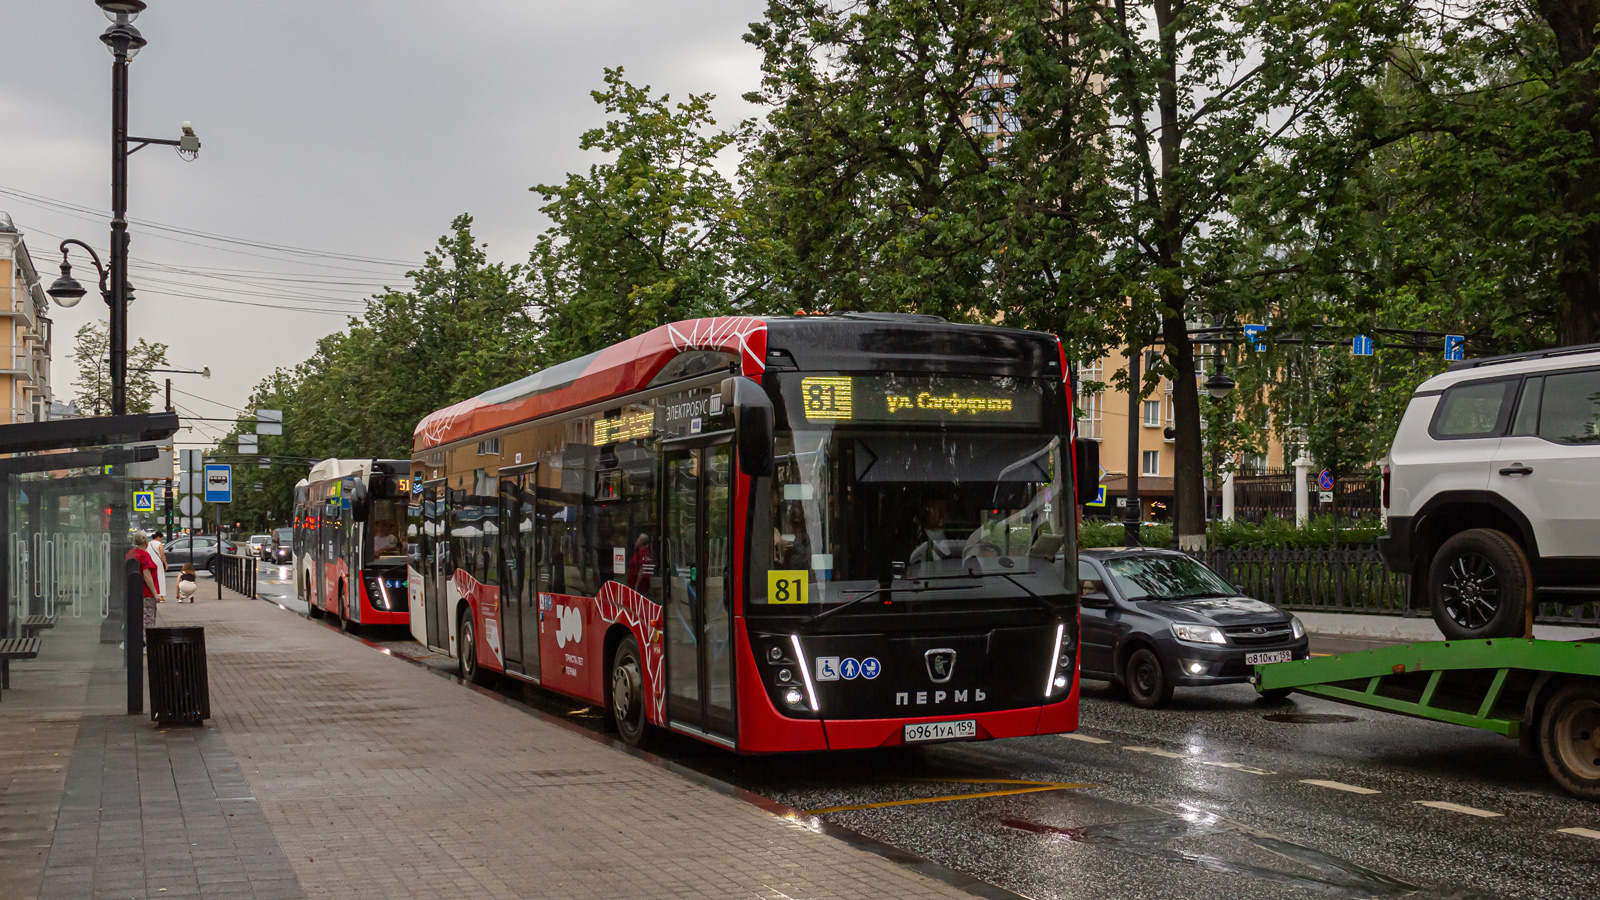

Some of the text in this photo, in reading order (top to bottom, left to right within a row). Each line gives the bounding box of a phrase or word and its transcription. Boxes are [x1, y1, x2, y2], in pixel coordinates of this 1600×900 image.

[666, 399, 707, 421] ЭЛЕКТРОБУС
[399, 479, 410, 491] 51
[775, 578, 802, 602] 81
[556, 605, 582, 649] 300
[896, 689, 986, 705] ПЕРМЬ
[908, 721, 974, 739] О961УА 159
